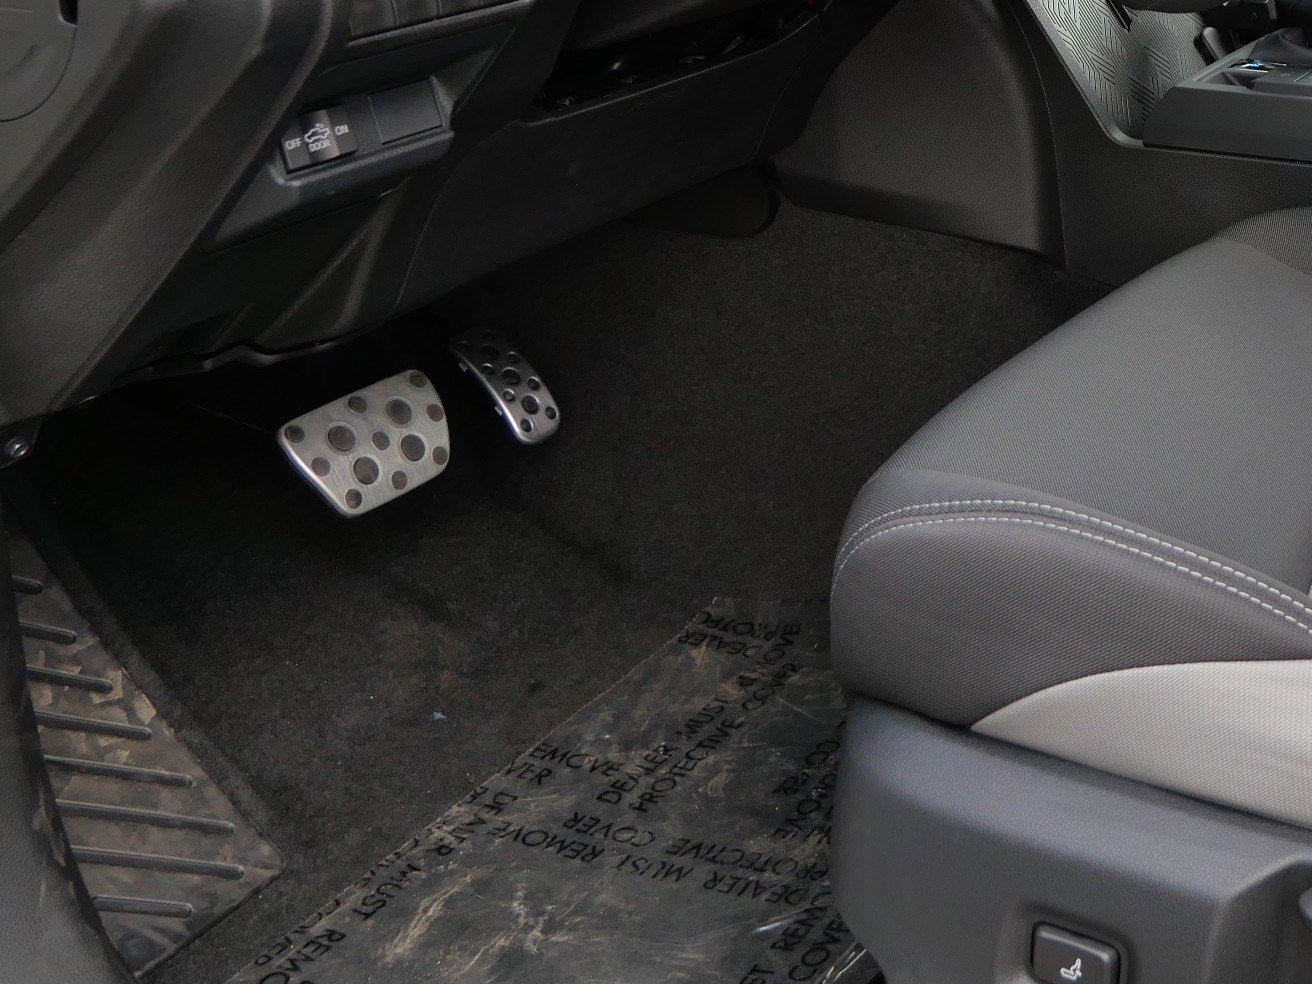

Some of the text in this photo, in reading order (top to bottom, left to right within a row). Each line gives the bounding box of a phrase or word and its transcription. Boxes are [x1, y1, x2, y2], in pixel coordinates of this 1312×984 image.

[285, 137, 302, 150] OFF
[334, 124, 349, 135] ON
[486, 821, 605, 863] REMOVE
[563, 812, 656, 847] COVER
[703, 871, 809, 906] DEALER
